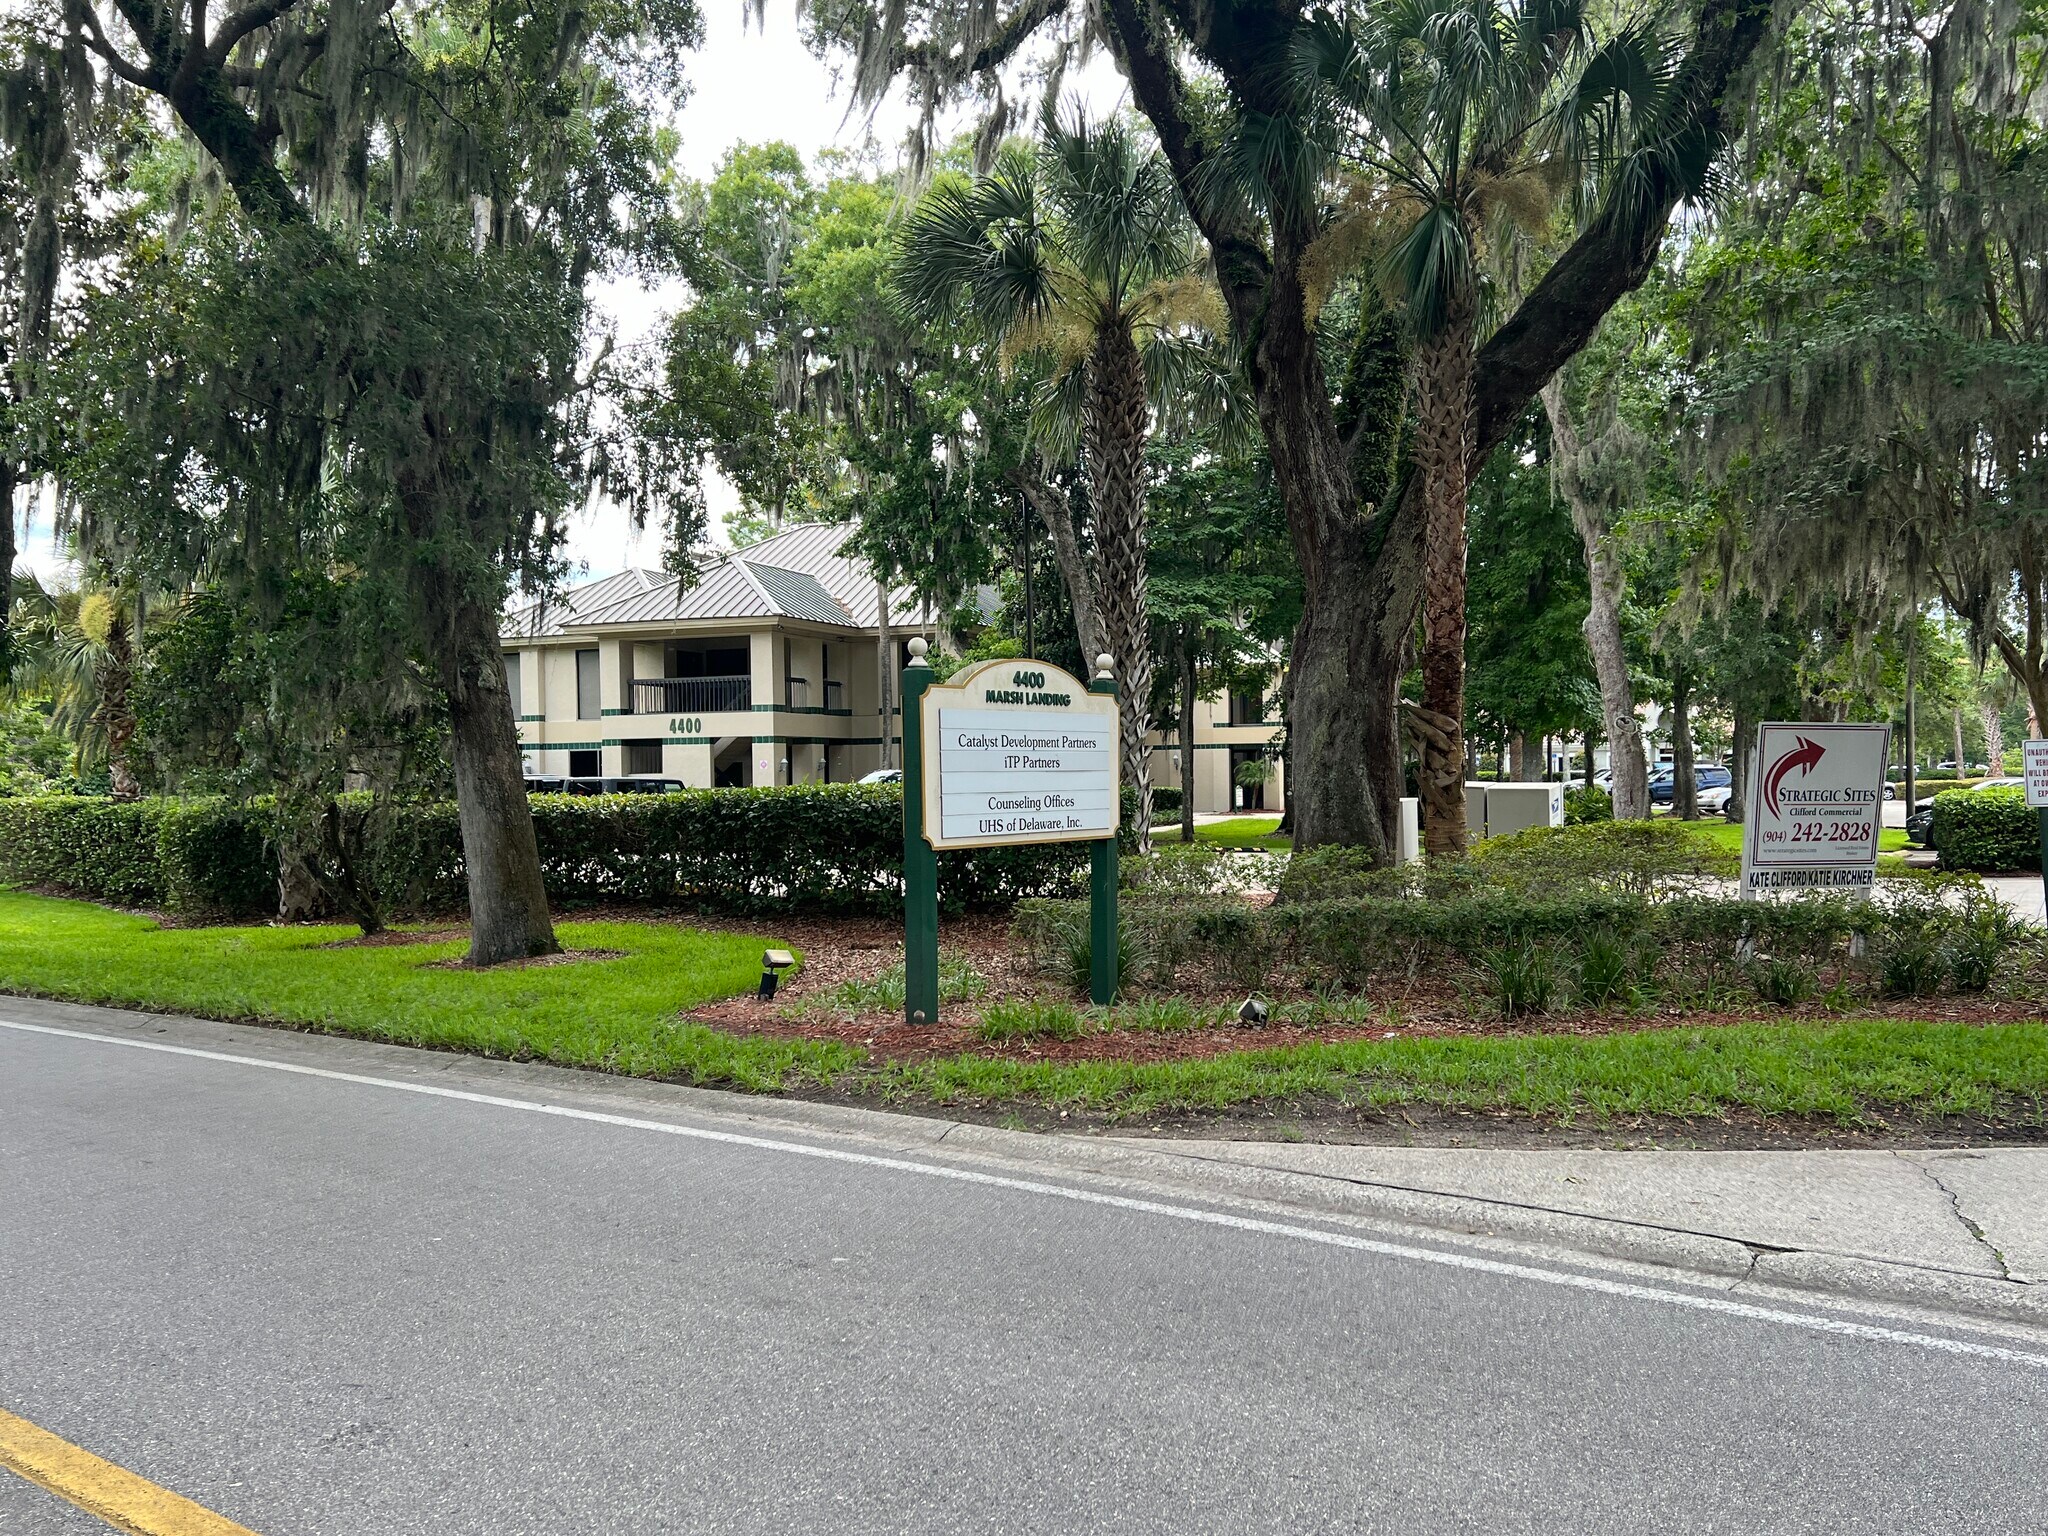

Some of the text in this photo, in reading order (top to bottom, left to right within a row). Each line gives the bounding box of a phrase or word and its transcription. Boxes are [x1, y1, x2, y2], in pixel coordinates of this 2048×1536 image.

[1013, 671, 1045, 688] 4400
[985, 690, 1071, 706] MARSH LANDING
[669, 717, 702, 734] 4400
[958, 734, 1097, 750] Catalyst Development Partners
[1004, 756, 1060, 769] iTP Partners
[1779, 787, 1876, 802] STRATEGIC SITES
[988, 795, 1075, 811] Counseling Offices
[1789, 808, 1862, 816] Clifford Commercial
[979, 816, 1083, 833] UHS of Delaware, Inc.
[1762, 822, 1871, 843] (904) 242-2828
[1749, 872, 1769, 888] KATE
[1832, 870, 1873, 886] KIRCHNER
